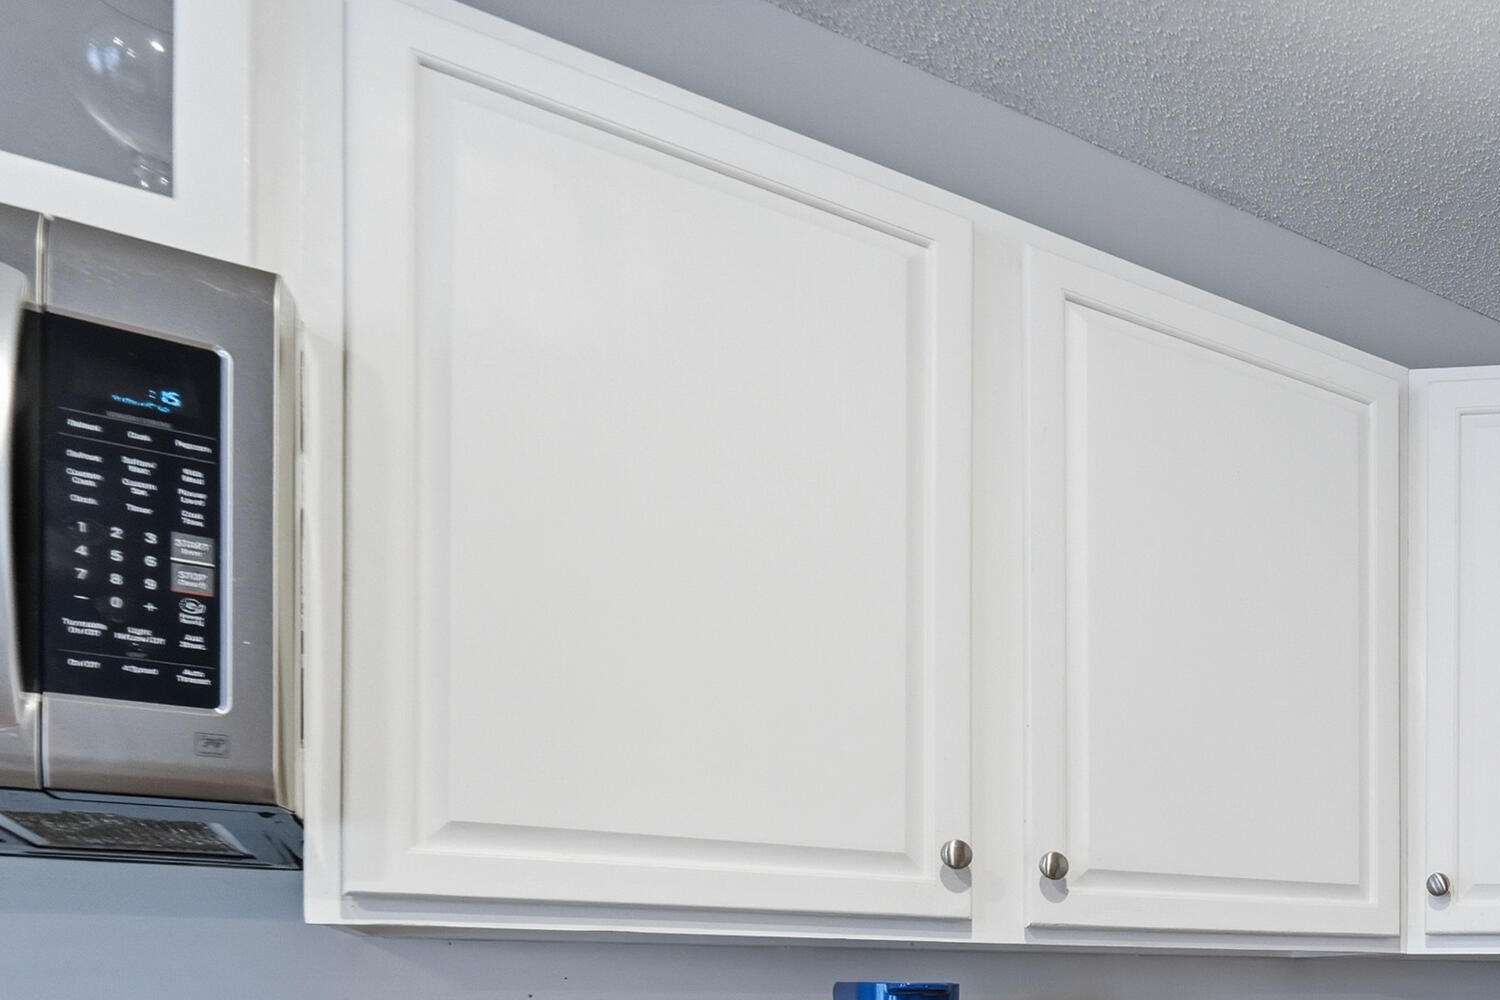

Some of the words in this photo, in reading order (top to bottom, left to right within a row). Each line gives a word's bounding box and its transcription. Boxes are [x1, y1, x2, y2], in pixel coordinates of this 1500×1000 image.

[76, 520, 88, 533] 1
[109, 526, 124, 539] 2
[144, 532, 159, 545] 3
[74, 544, 89, 556] 4
[109, 549, 124, 562] 5
[144, 555, 158, 567] 6
[74, 567, 88, 580] 7
[109, 572, 124, 585] 8
[144, 578, 158, 590] 9
[109, 595, 124, 609] 0
